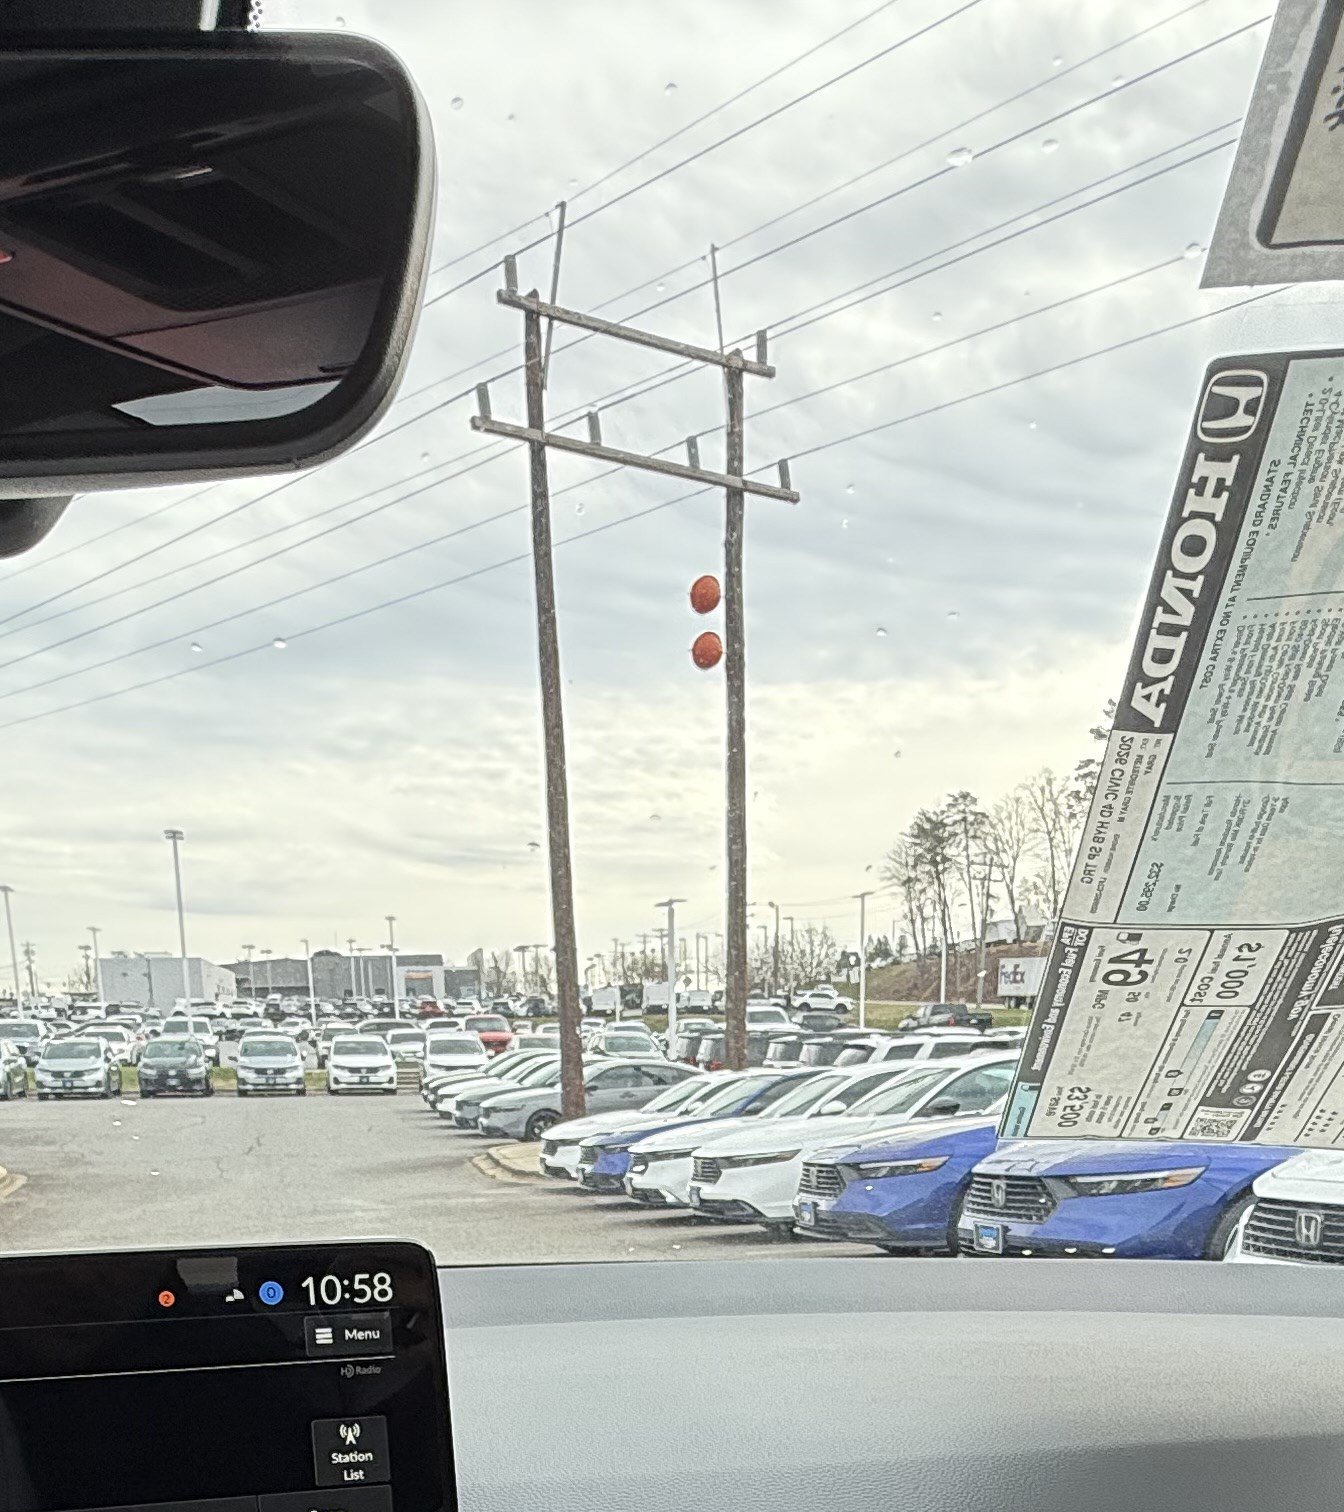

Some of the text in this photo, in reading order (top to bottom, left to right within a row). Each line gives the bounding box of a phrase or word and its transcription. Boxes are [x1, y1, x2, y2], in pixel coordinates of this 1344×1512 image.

[301, 1273, 393, 1306] 10:58
[344, 1328, 380, 1341] Menu
[356, 1365, 382, 1376] Radio
[331, 1449, 374, 1464] Station
[343, 1468, 364, 1481] List
